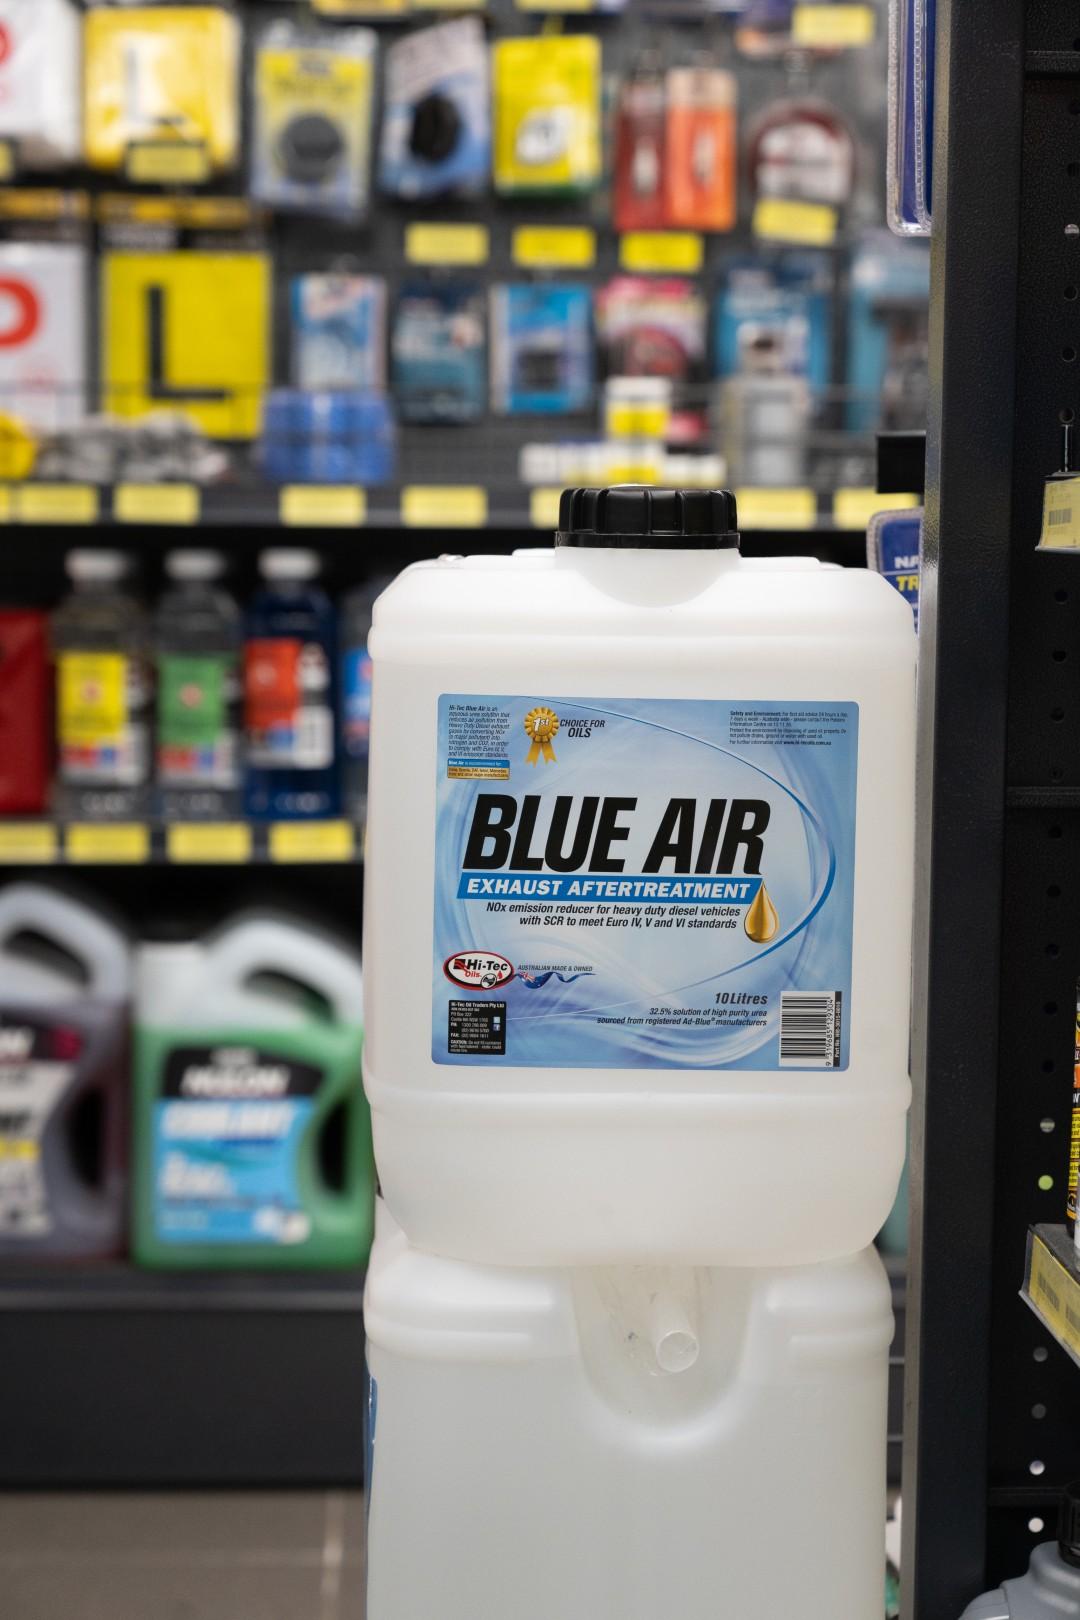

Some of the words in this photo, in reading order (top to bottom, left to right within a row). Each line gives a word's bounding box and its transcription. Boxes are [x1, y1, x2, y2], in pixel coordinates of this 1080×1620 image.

[146, 284, 229, 402] L
[533, 717, 550, 732] 1st
[560, 719, 588, 727] CHOICE
[590, 720, 606, 728] FOR
[568, 728, 592, 738] OILS
[462, 794, 638, 872] BLUE
[642, 798, 771, 875] AIR
[467, 879, 562, 895] EXHAUST
[567, 881, 750, 899] AFTERTREATMENT
[486, 902, 507, 913] NOx
[509, 904, 553, 914] emission
[556, 904, 594, 914] reducer
[596, 904, 610, 914] for
[612, 904, 642, 917] heavy
[644, 906, 666, 918] duty
[668, 906, 698, 916] diesel
[700, 906, 740, 916] vehicles
[520, 916, 540, 925] with
[543, 916, 564, 926] SCR
[566, 918, 576, 926] to
[578, 918, 604, 927] meet
[606, 918, 628, 927] Euro
[631, 918, 643, 928] IV,
[646, 918, 652, 928] V
[654, 918, 673, 928] and
[676, 918, 685, 928] VI
[688, 919, 737, 929] standards
[467, 959, 508, 971] Hi-Tec
[649, 1008, 671, 1016] 32.5%
[673, 1008, 701, 1016] solution
[702, 1008, 710, 1016] of
[712, 1009, 727, 1018] high
[728, 1009, 749, 1019] purity
[645, 1017, 680, 1026] registered
[716, 1018, 767, 1026] manufacturers
